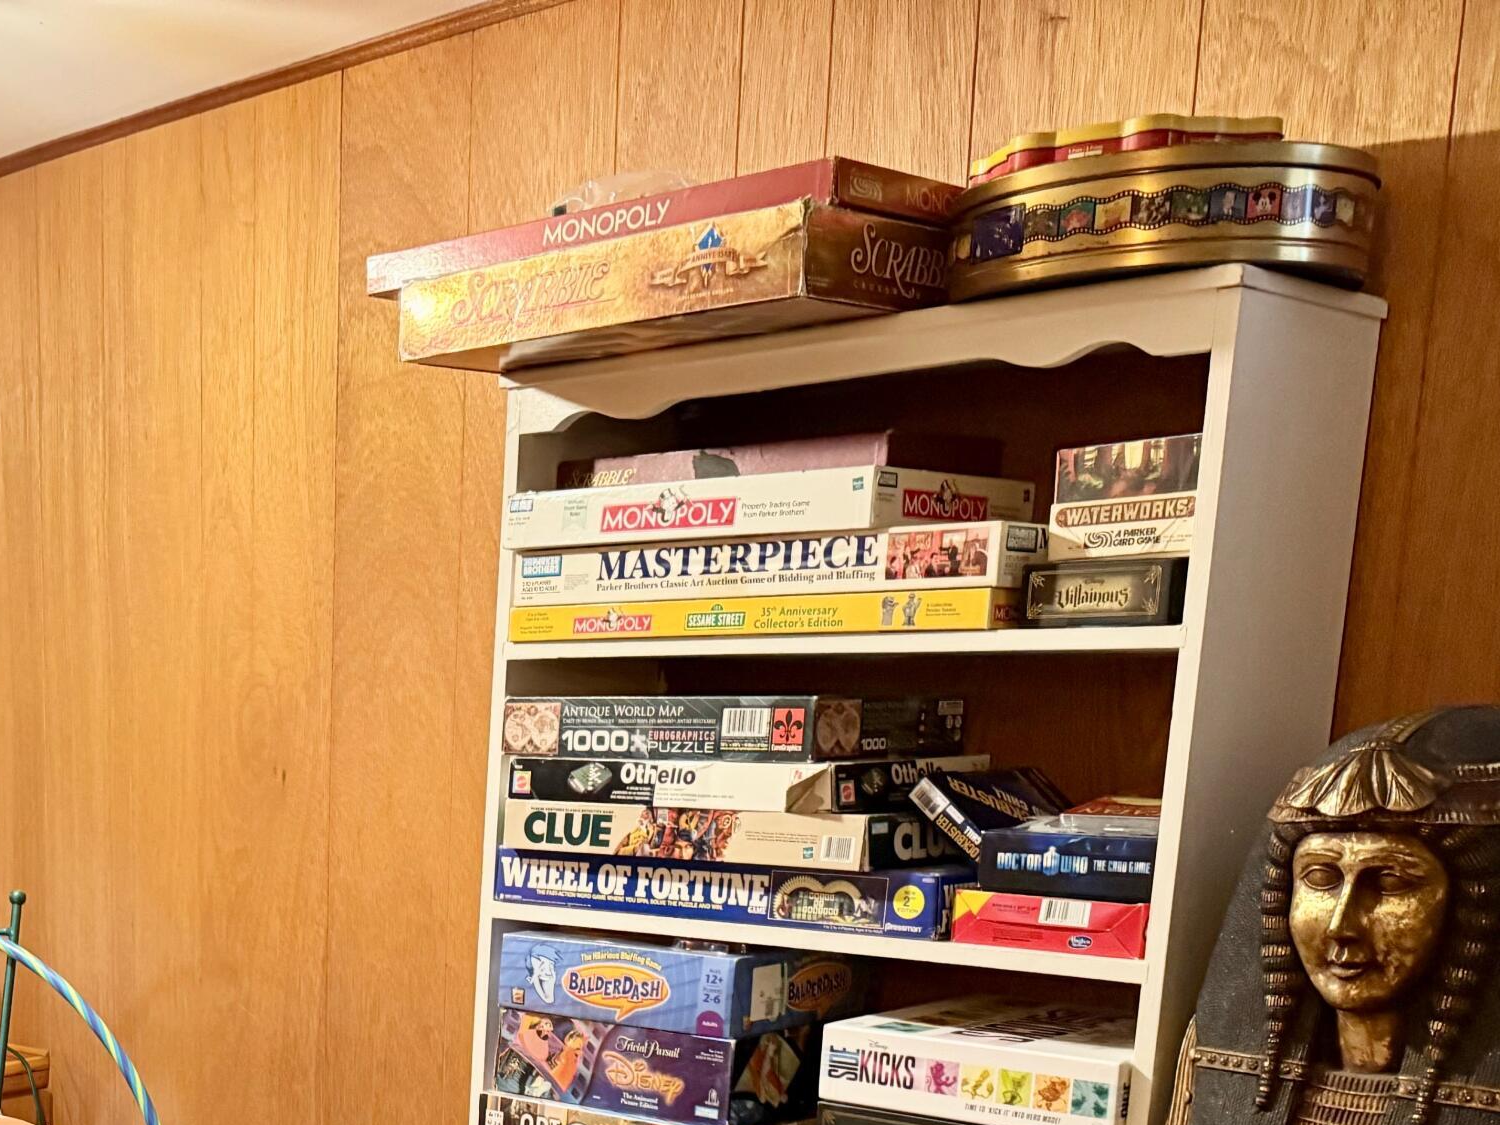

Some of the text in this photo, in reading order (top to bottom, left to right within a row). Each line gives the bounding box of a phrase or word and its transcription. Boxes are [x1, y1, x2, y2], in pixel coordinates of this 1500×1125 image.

[542, 199, 670, 246] MONOPOLY
[851, 223, 948, 299] SCRABB
[602, 500, 735, 531] MONOPOLY
[741, 499, 811, 512] Property Trading Game
[759, 509, 778, 518] Parker
[779, 508, 805, 517] Brothers
[904, 492, 987, 521] MONOPOLY
[1065, 498, 1189, 527] WATERWORKS
[1112, 535, 1161, 547] CARD GAME
[1123, 527, 1157, 537] PARKER
[596, 533, 879, 581] MASTERPIECE
[596, 582, 623, 592] Parker
[624, 581, 659, 591] Brothers
[660, 579, 689, 588] Classic
[690, 577, 704, 587] Art
[705, 575, 739, 586] Auction
[740, 575, 766, 584] Game
[766, 573, 776, 583] of
[778, 572, 815, 584] Bidding
[816, 571, 834, 582] and
[836, 569, 876, 582] Bluffing
[1057, 584, 1130, 609] Villainous
[688, 612, 746, 627] SESAME STREET
[753, 616, 844, 629] Collector's Edition
[778, 605, 839, 617] Anniversary
[574, 616, 652, 633] MONOPOLY
[561, 704, 685, 720] ANTIQUE WORLD MAP
[561, 729, 630, 752] 1000
[648, 729, 716, 741] EUROGRAPHICS
[860, 737, 888, 751] 1000
[647, 741, 716, 754] PUZZLE
[619, 762, 697, 786] Othello
[524, 810, 612, 848] CLUE
[936, 814, 980, 863] OCKBUSTER
[894, 821, 946, 862] CLU
[996, 851, 1089, 874] DOCTOR WHO
[1093, 858, 1106, 872] THE
[1128, 860, 1152, 875] GAME
[501, 856, 771, 908] WHEEL OF FORTUNE
[581, 953, 592, 962] The
[592, 951, 620, 961] Hilarious
[645, 957, 662, 972] Game
[568, 970, 662, 1001] BALDERDASH
[705, 974, 723, 984] 12+
[789, 970, 847, 1002] BALDERDASH
[703, 994, 721, 1004] 2-6
[615, 1036, 647, 1054] Trivial
[643, 1039, 681, 1059] Pursuit
[602, 1050, 685, 1106] Disney
[828, 1045, 916, 1090] SIDE KICKS
[623, 1091, 633, 1100] The
[639, 1101, 659, 1111] Edition
